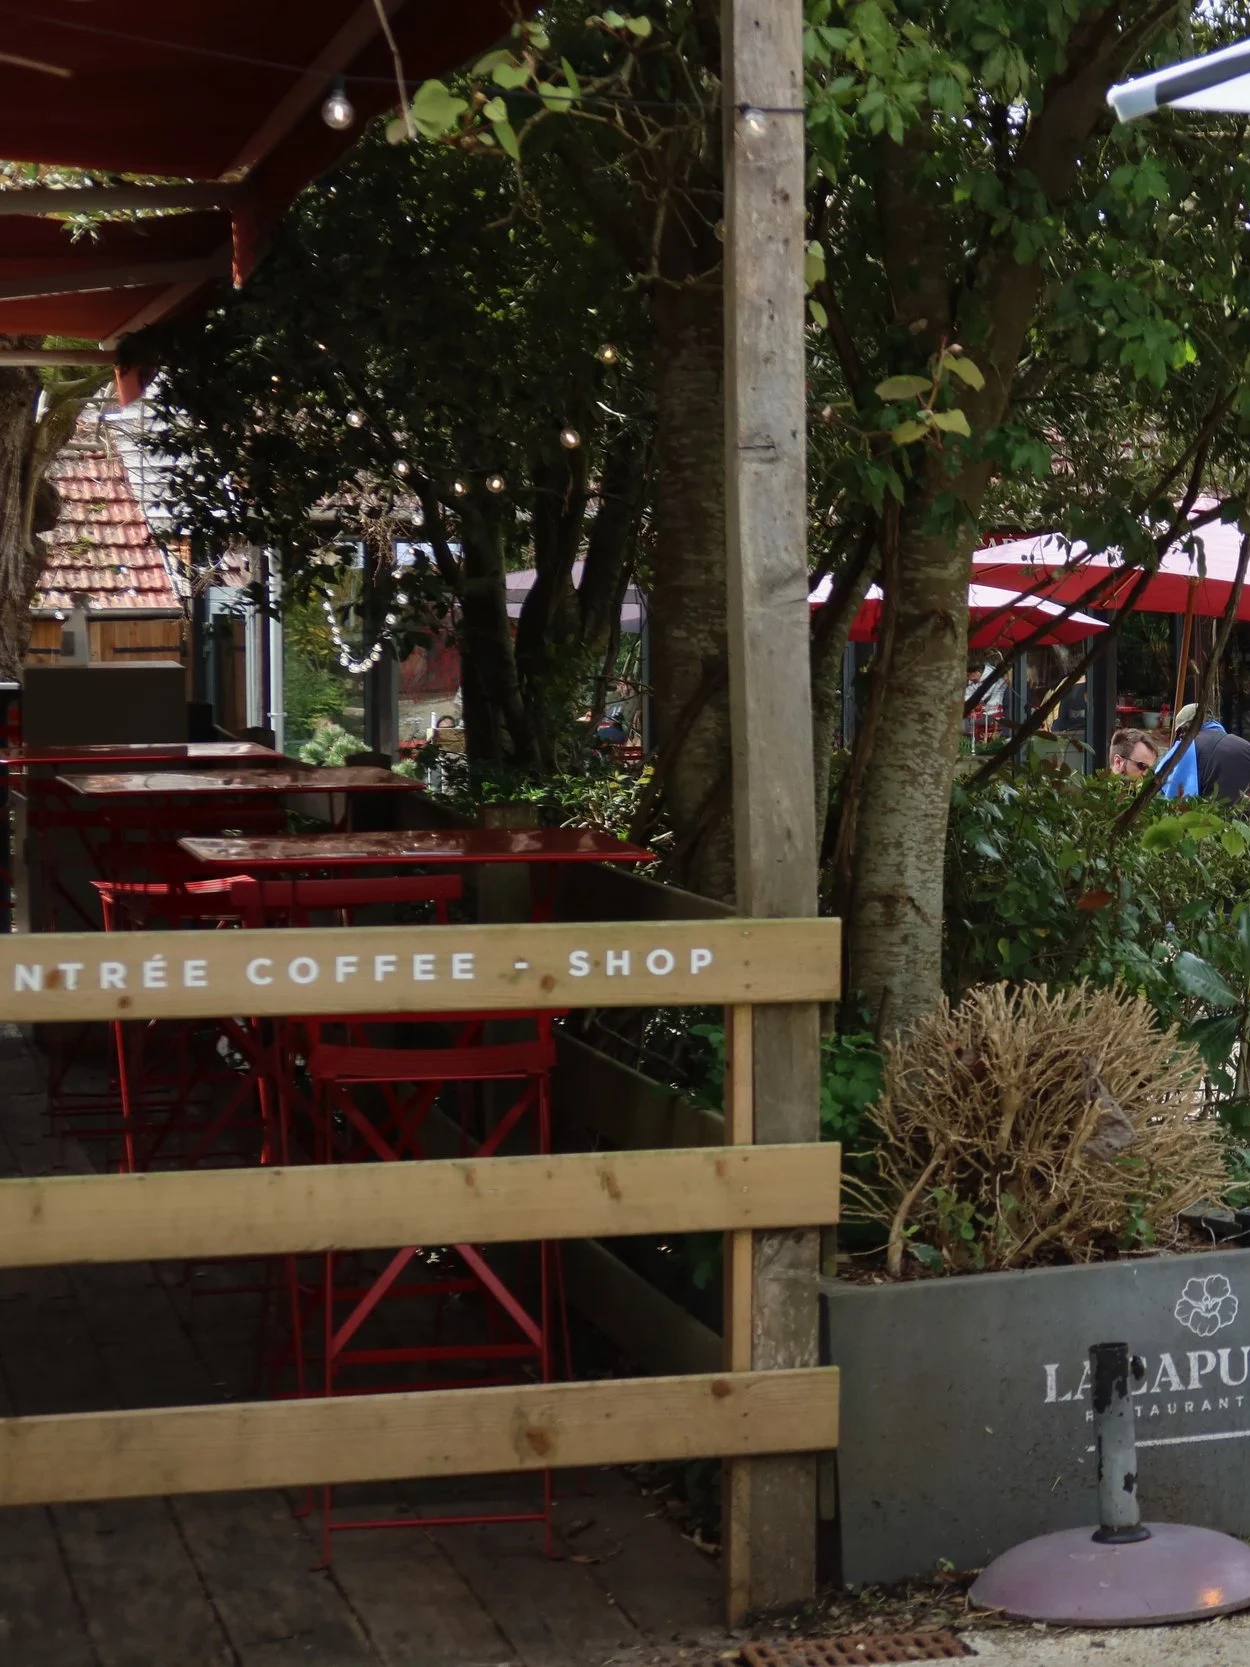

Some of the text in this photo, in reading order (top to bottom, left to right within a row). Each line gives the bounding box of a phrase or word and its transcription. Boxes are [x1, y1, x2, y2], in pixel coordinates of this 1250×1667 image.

[14, 954, 209, 992] NTRÉE
[246, 952, 478, 987] COFFEE
[568, 948, 714, 978] SHOP
[1085, 1396, 1245, 1422] RTAURANT
